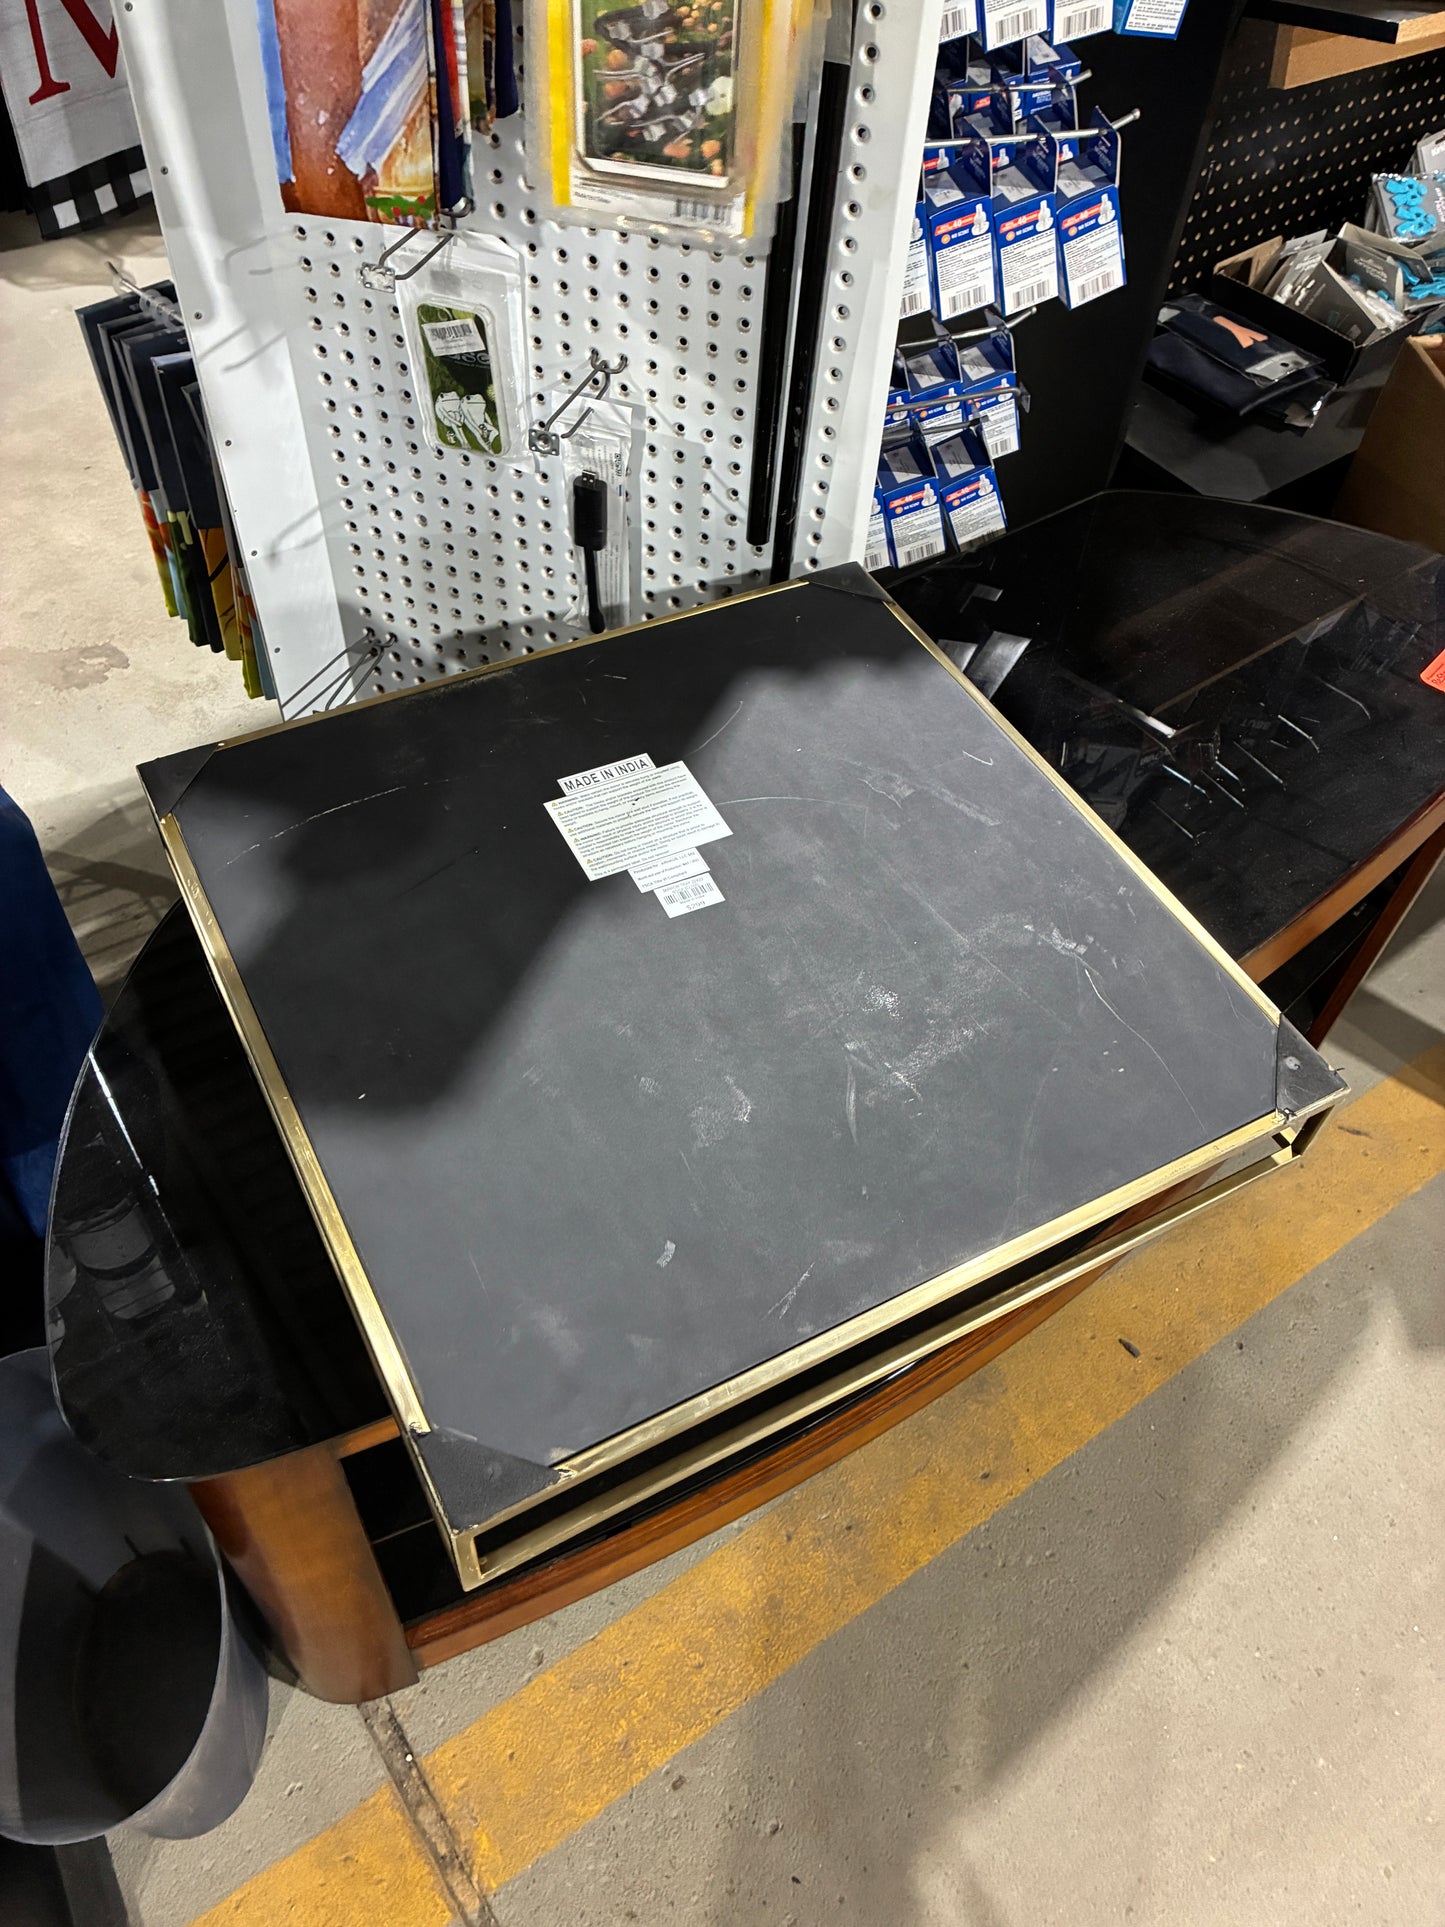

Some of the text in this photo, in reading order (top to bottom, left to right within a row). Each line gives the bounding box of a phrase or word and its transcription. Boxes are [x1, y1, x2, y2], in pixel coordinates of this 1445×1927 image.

[564, 759, 648, 791] MADE IN INDIA
